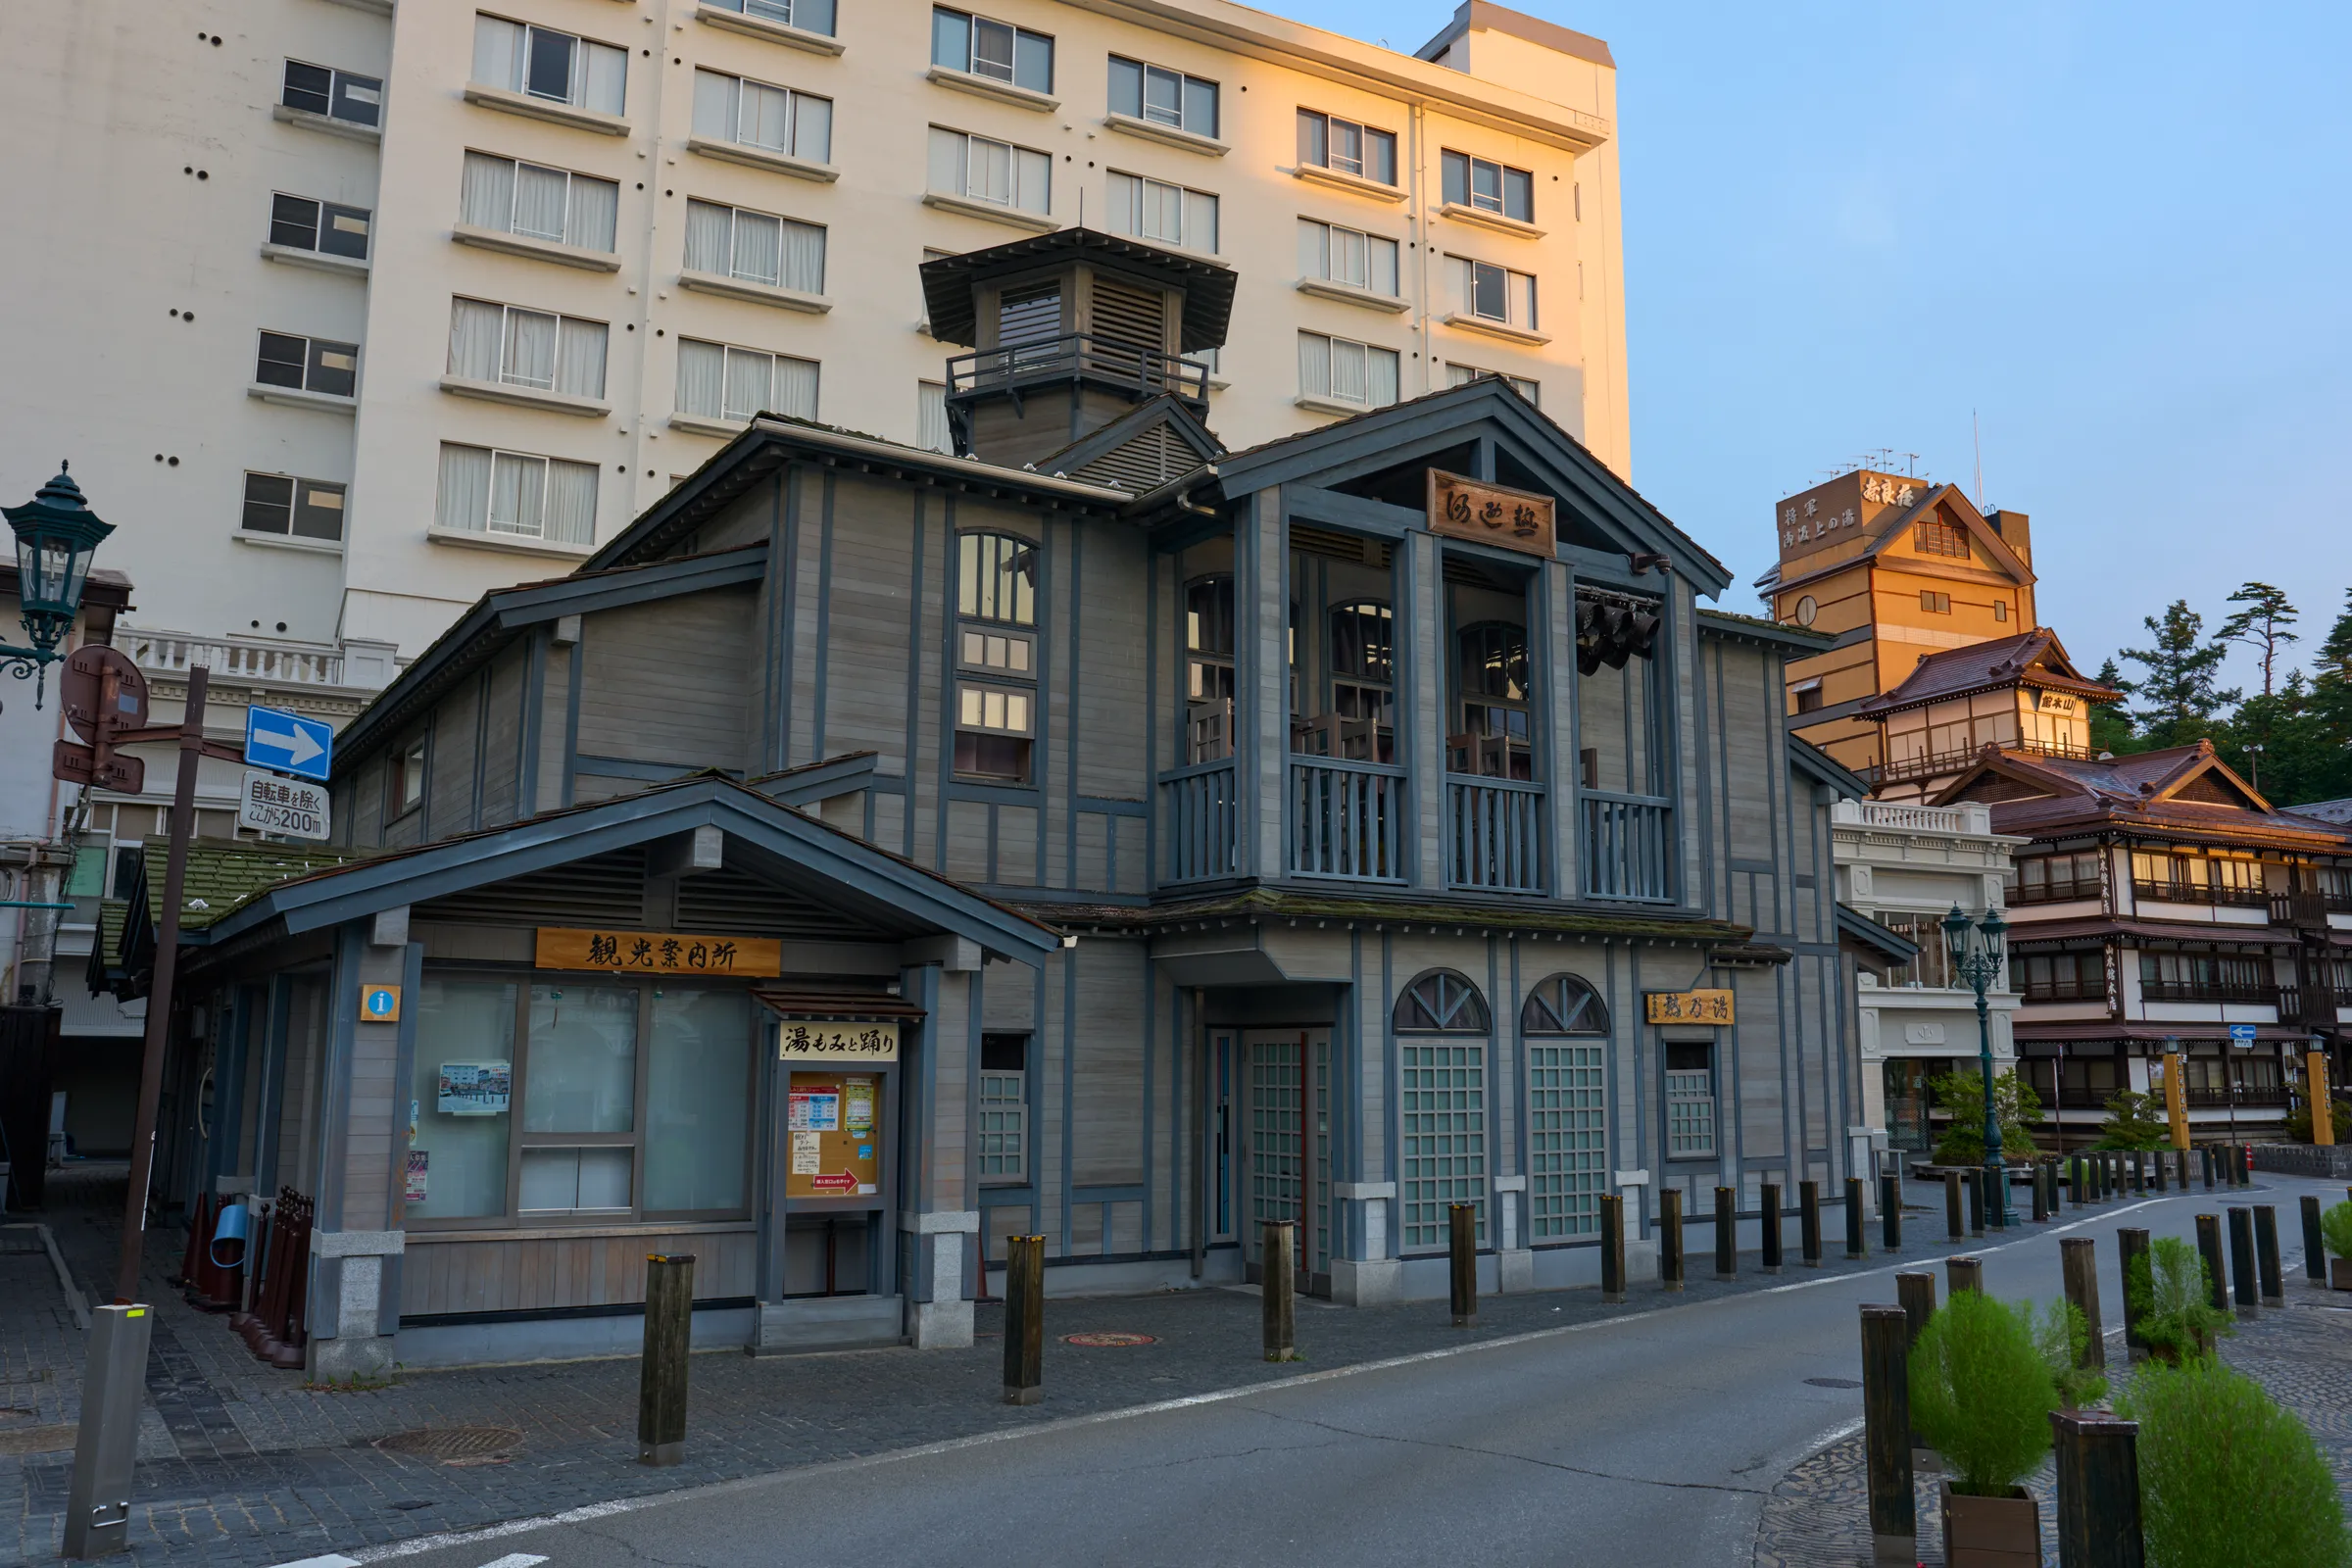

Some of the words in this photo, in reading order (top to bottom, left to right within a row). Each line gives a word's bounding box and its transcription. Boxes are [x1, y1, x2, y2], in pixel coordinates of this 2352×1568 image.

[251, 780, 320, 810] 自転車を除く
[249, 804, 320, 833] ここから200m
[585, 934, 737, 971] 観光案内所
[785, 1026, 894, 1055] 湯もみと踊り
